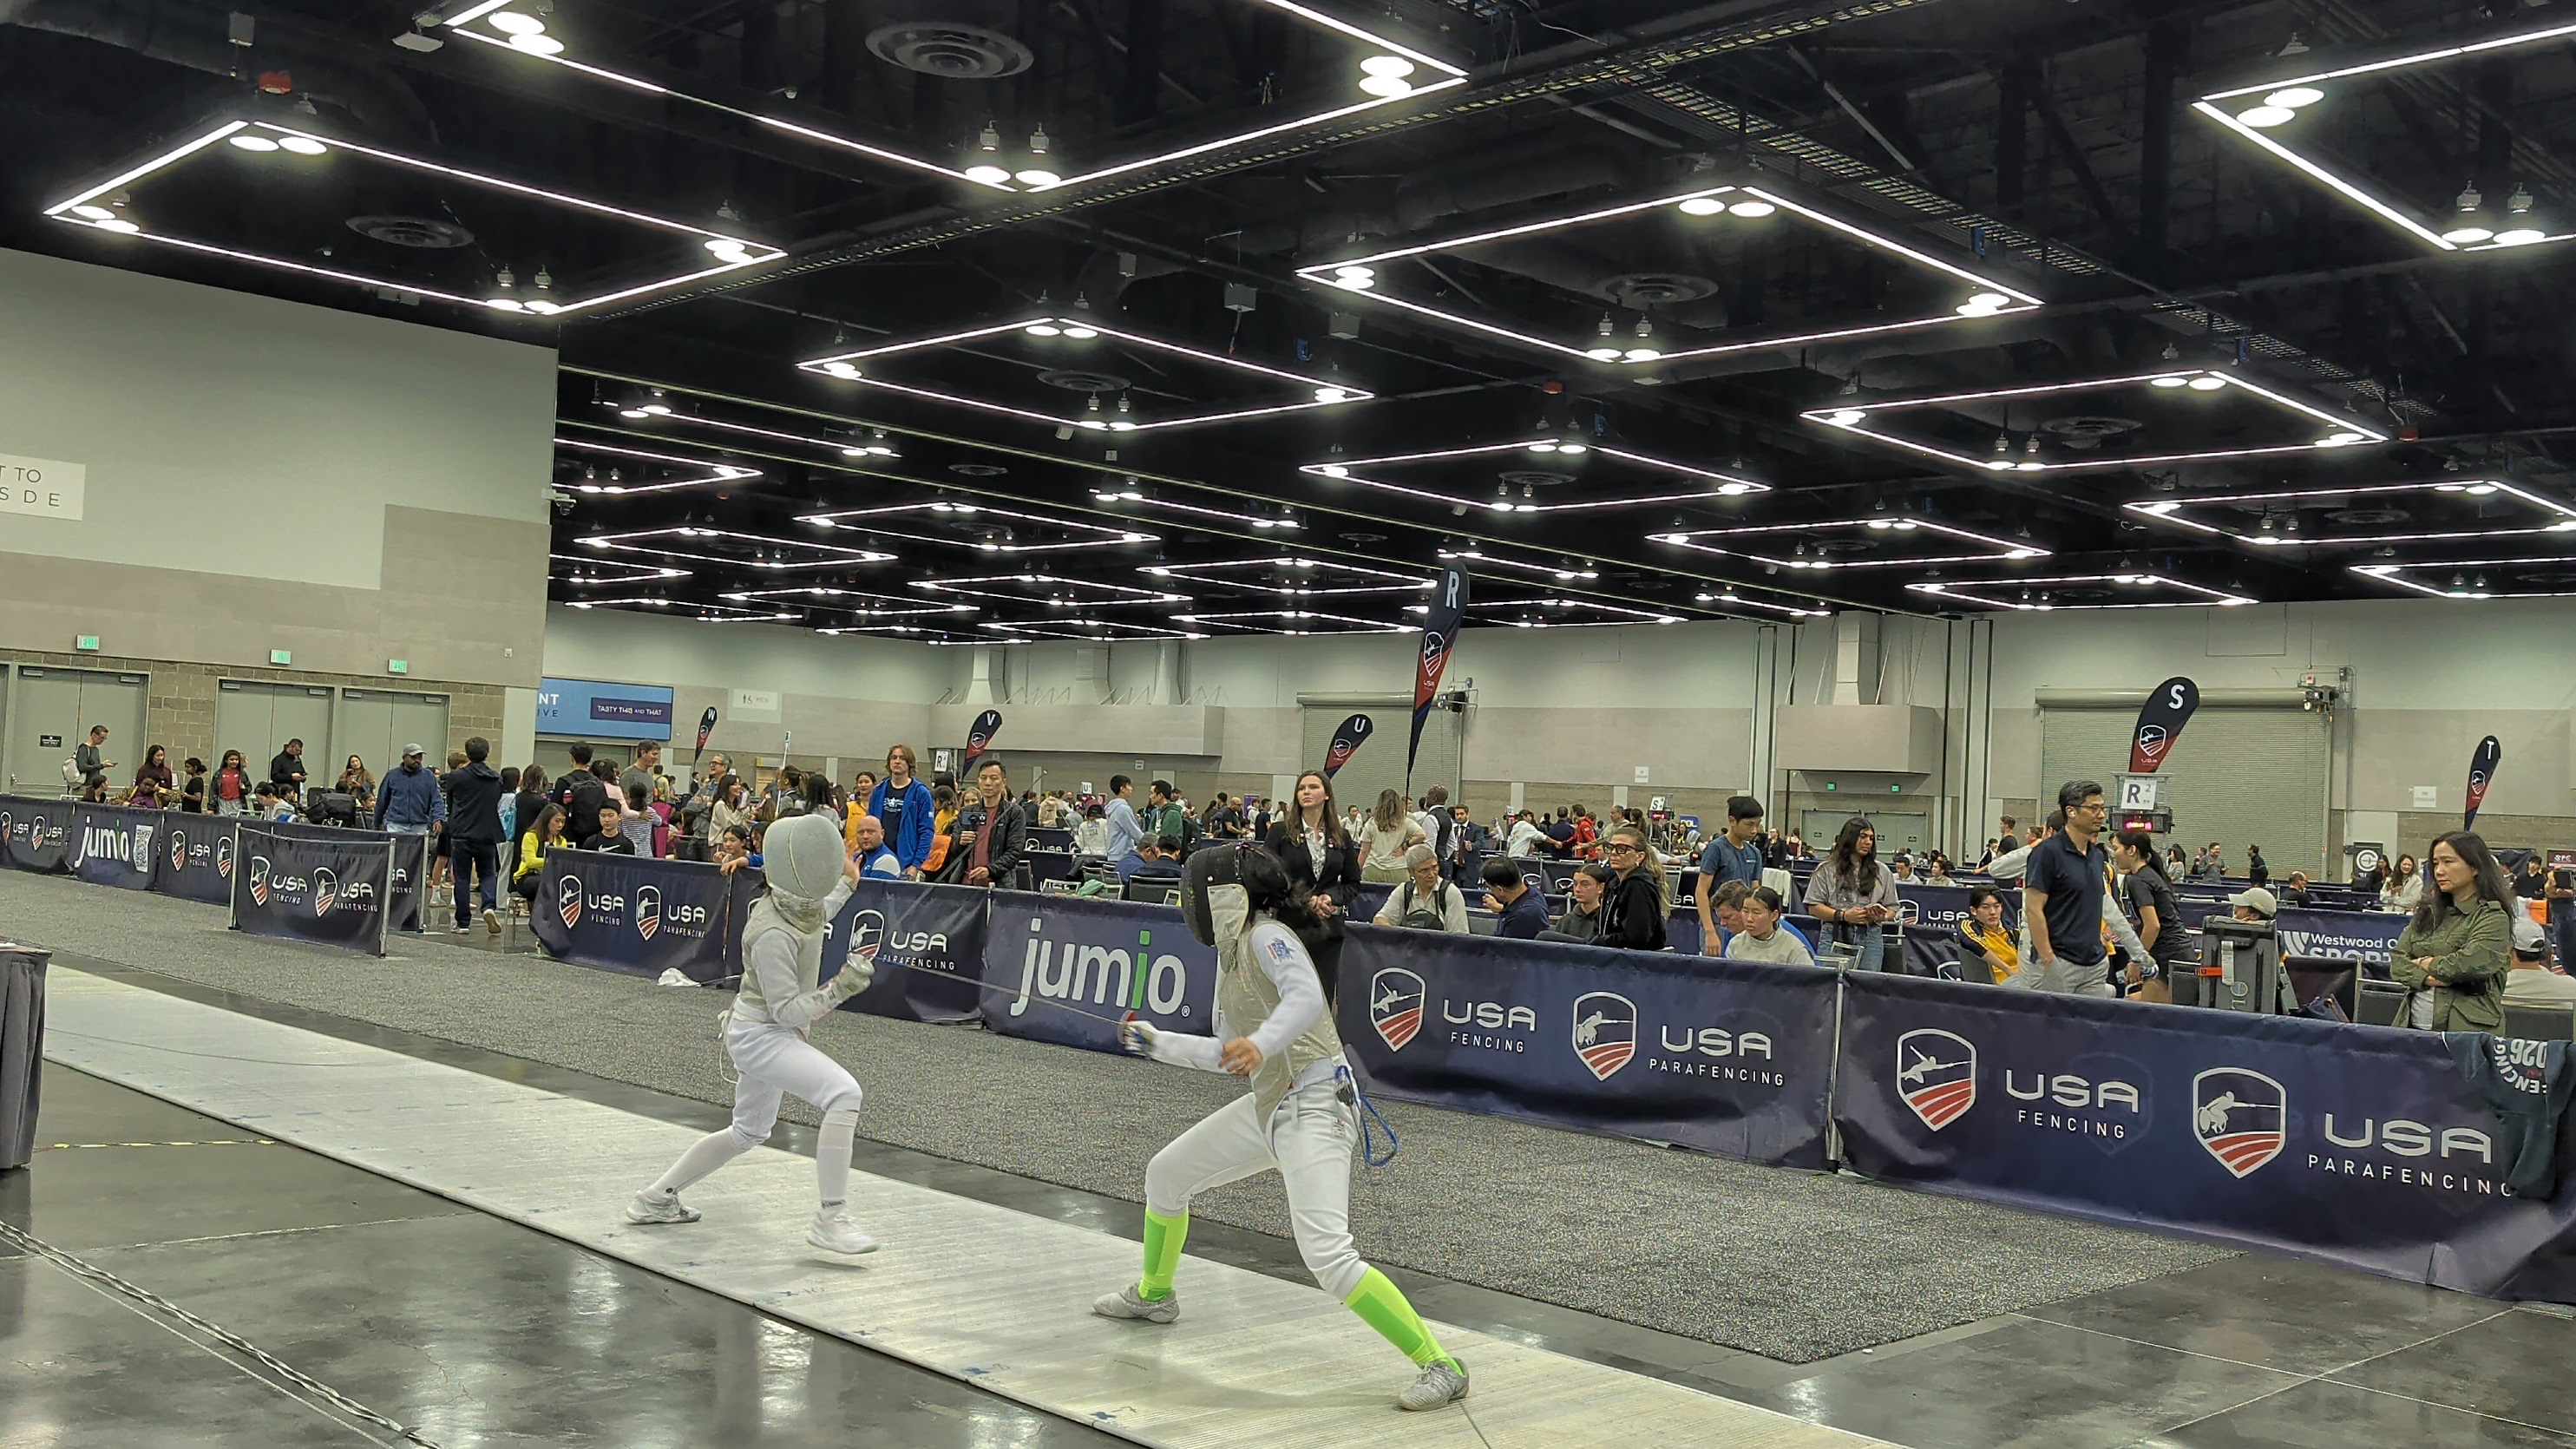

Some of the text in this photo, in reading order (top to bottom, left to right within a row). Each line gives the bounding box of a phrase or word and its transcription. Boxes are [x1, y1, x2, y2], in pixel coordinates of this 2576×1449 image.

[14, 467, 42, 482] TO
[1445, 571, 1459, 609] R
[2168, 684, 2186, 710] S
[597, 705, 618, 713] TASTY
[707, 708, 716, 720] W
[986, 712, 996, 726] V
[1354, 718, 1366, 733] U
[2487, 740, 2494, 759] T
[937, 755, 942, 768] R
[2127, 784, 2152, 803] R 2
[1652, 799, 1660, 810] S
[13, 823, 29, 834] USA
[46, 827, 62, 838] USA
[188, 843, 211, 857] USA
[272, 875, 308, 893] USA
[341, 882, 374, 899] USA
[272, 893, 302, 905] FENCING
[333, 902, 378, 913] PARAFENCING
[588, 893, 625, 912] USA
[591, 913, 621, 926] FENCING
[668, 904, 706, 924] USA
[889, 930, 947, 953] USA
[2311, 933, 2383, 948] Westwood
[882, 954, 955, 970] PARAFENCING
[1443, 999, 1537, 1033] USA
[1450, 1031, 1525, 1053] FENCING
[1661, 1024, 1772, 1060] USA
[1649, 1058, 1785, 1086] PARAFENCING
[2004, 1068, 2140, 1114] USA
[2017, 1109, 2126, 1139] FENCING
[2324, 1111, 2492, 1164] USA
